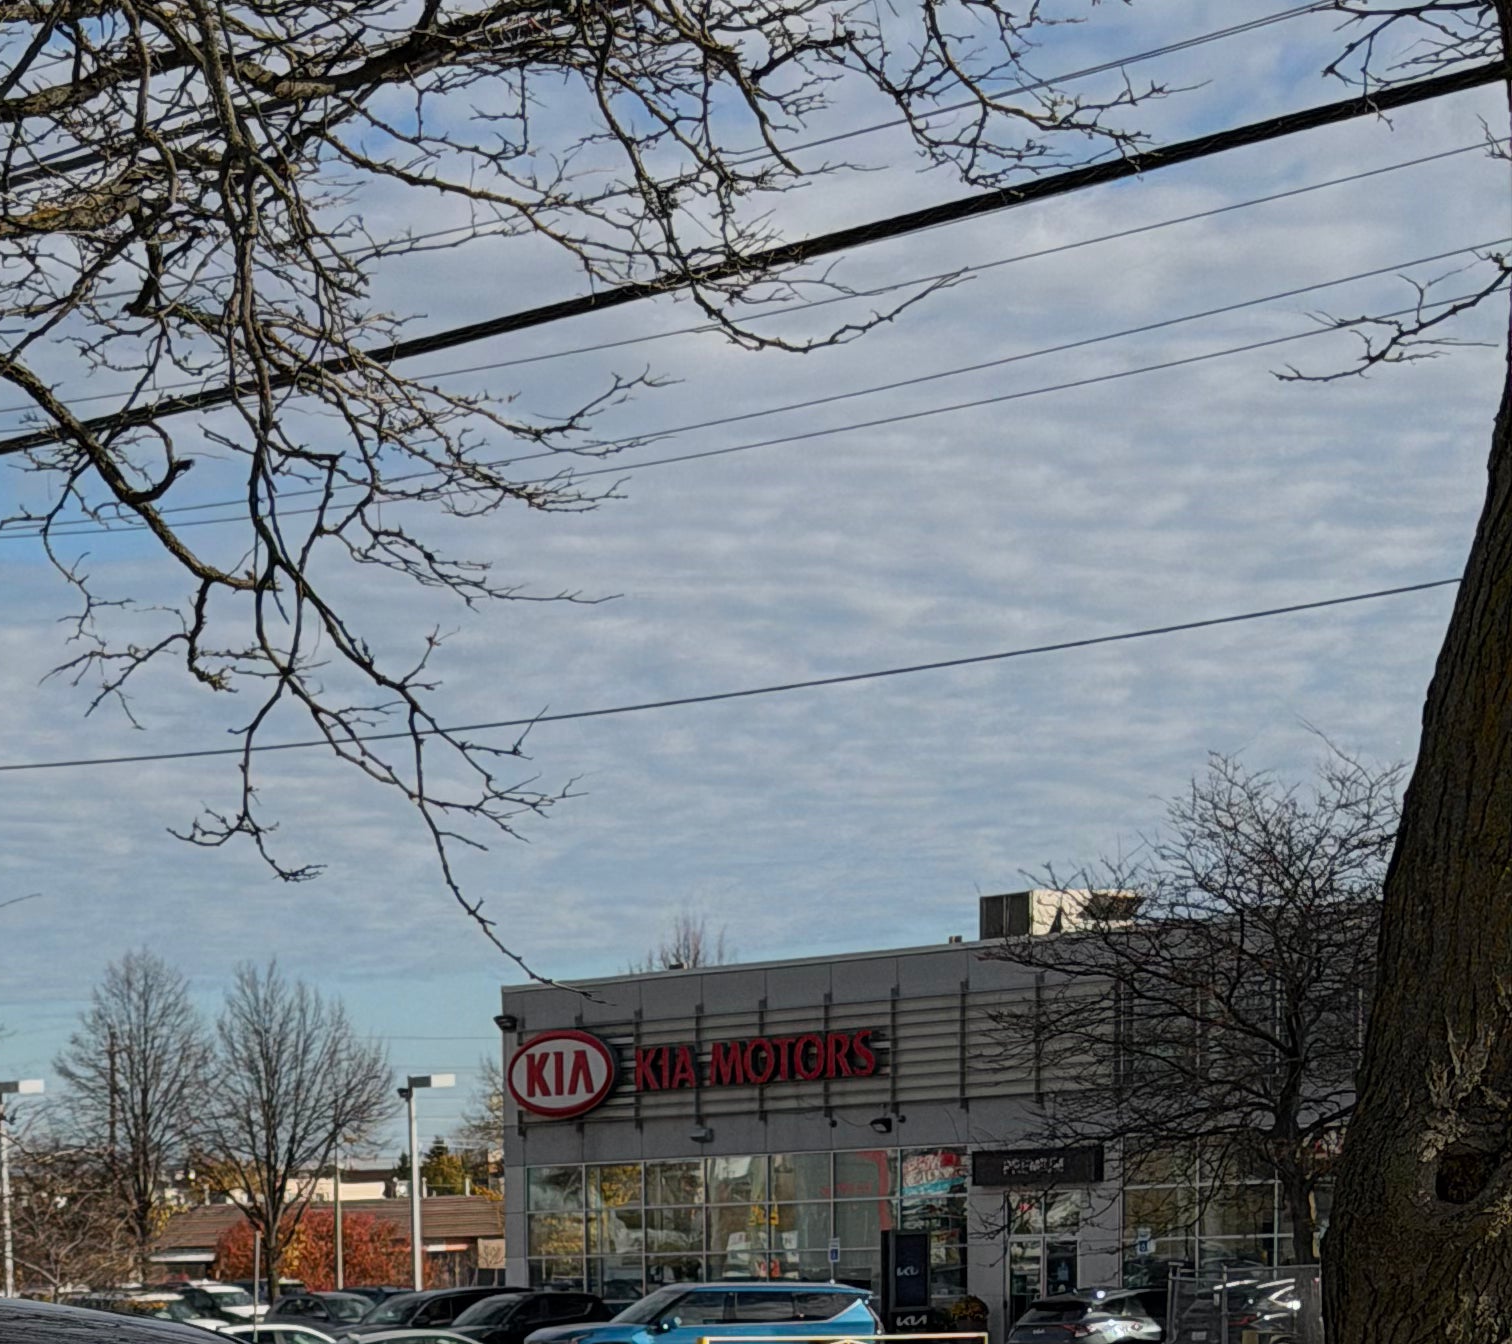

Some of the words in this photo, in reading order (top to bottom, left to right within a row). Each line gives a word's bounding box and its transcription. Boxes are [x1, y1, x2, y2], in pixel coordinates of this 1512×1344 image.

[526, 1049, 595, 1098] KIA
[634, 1044, 696, 1093] KIA
[709, 1030, 877, 1086] MOTORS
